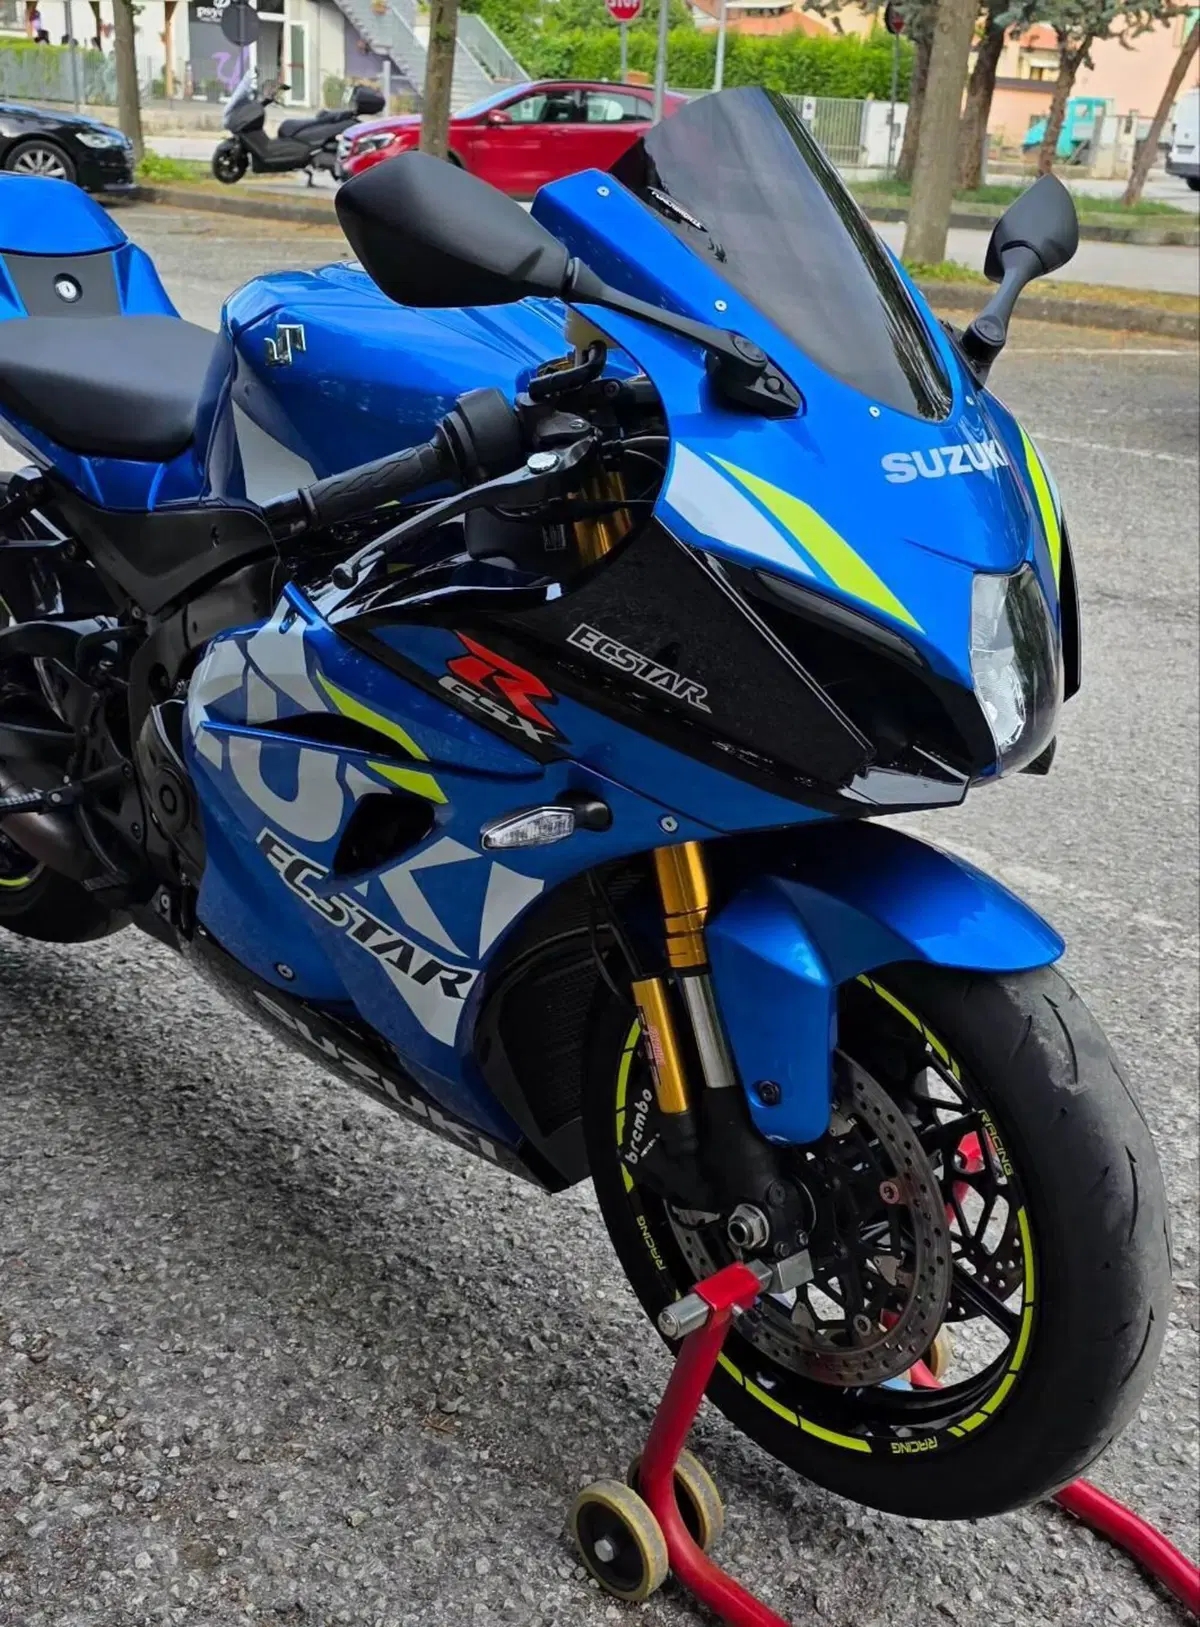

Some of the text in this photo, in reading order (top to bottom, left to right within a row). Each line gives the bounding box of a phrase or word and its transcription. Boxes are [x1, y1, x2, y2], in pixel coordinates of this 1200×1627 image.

[566, 622, 712, 714] ECSTAR
[438, 674, 556, 744] GSX
[256, 826, 480, 1001] ECSTAR
[253, 990, 498, 1161] SUZUKI
[625, 1088, 653, 1165] brembo
[979, 1109, 1014, 1176] RACING
[636, 1215, 667, 1271] RACING
[890, 1435, 938, 1454] RACING
